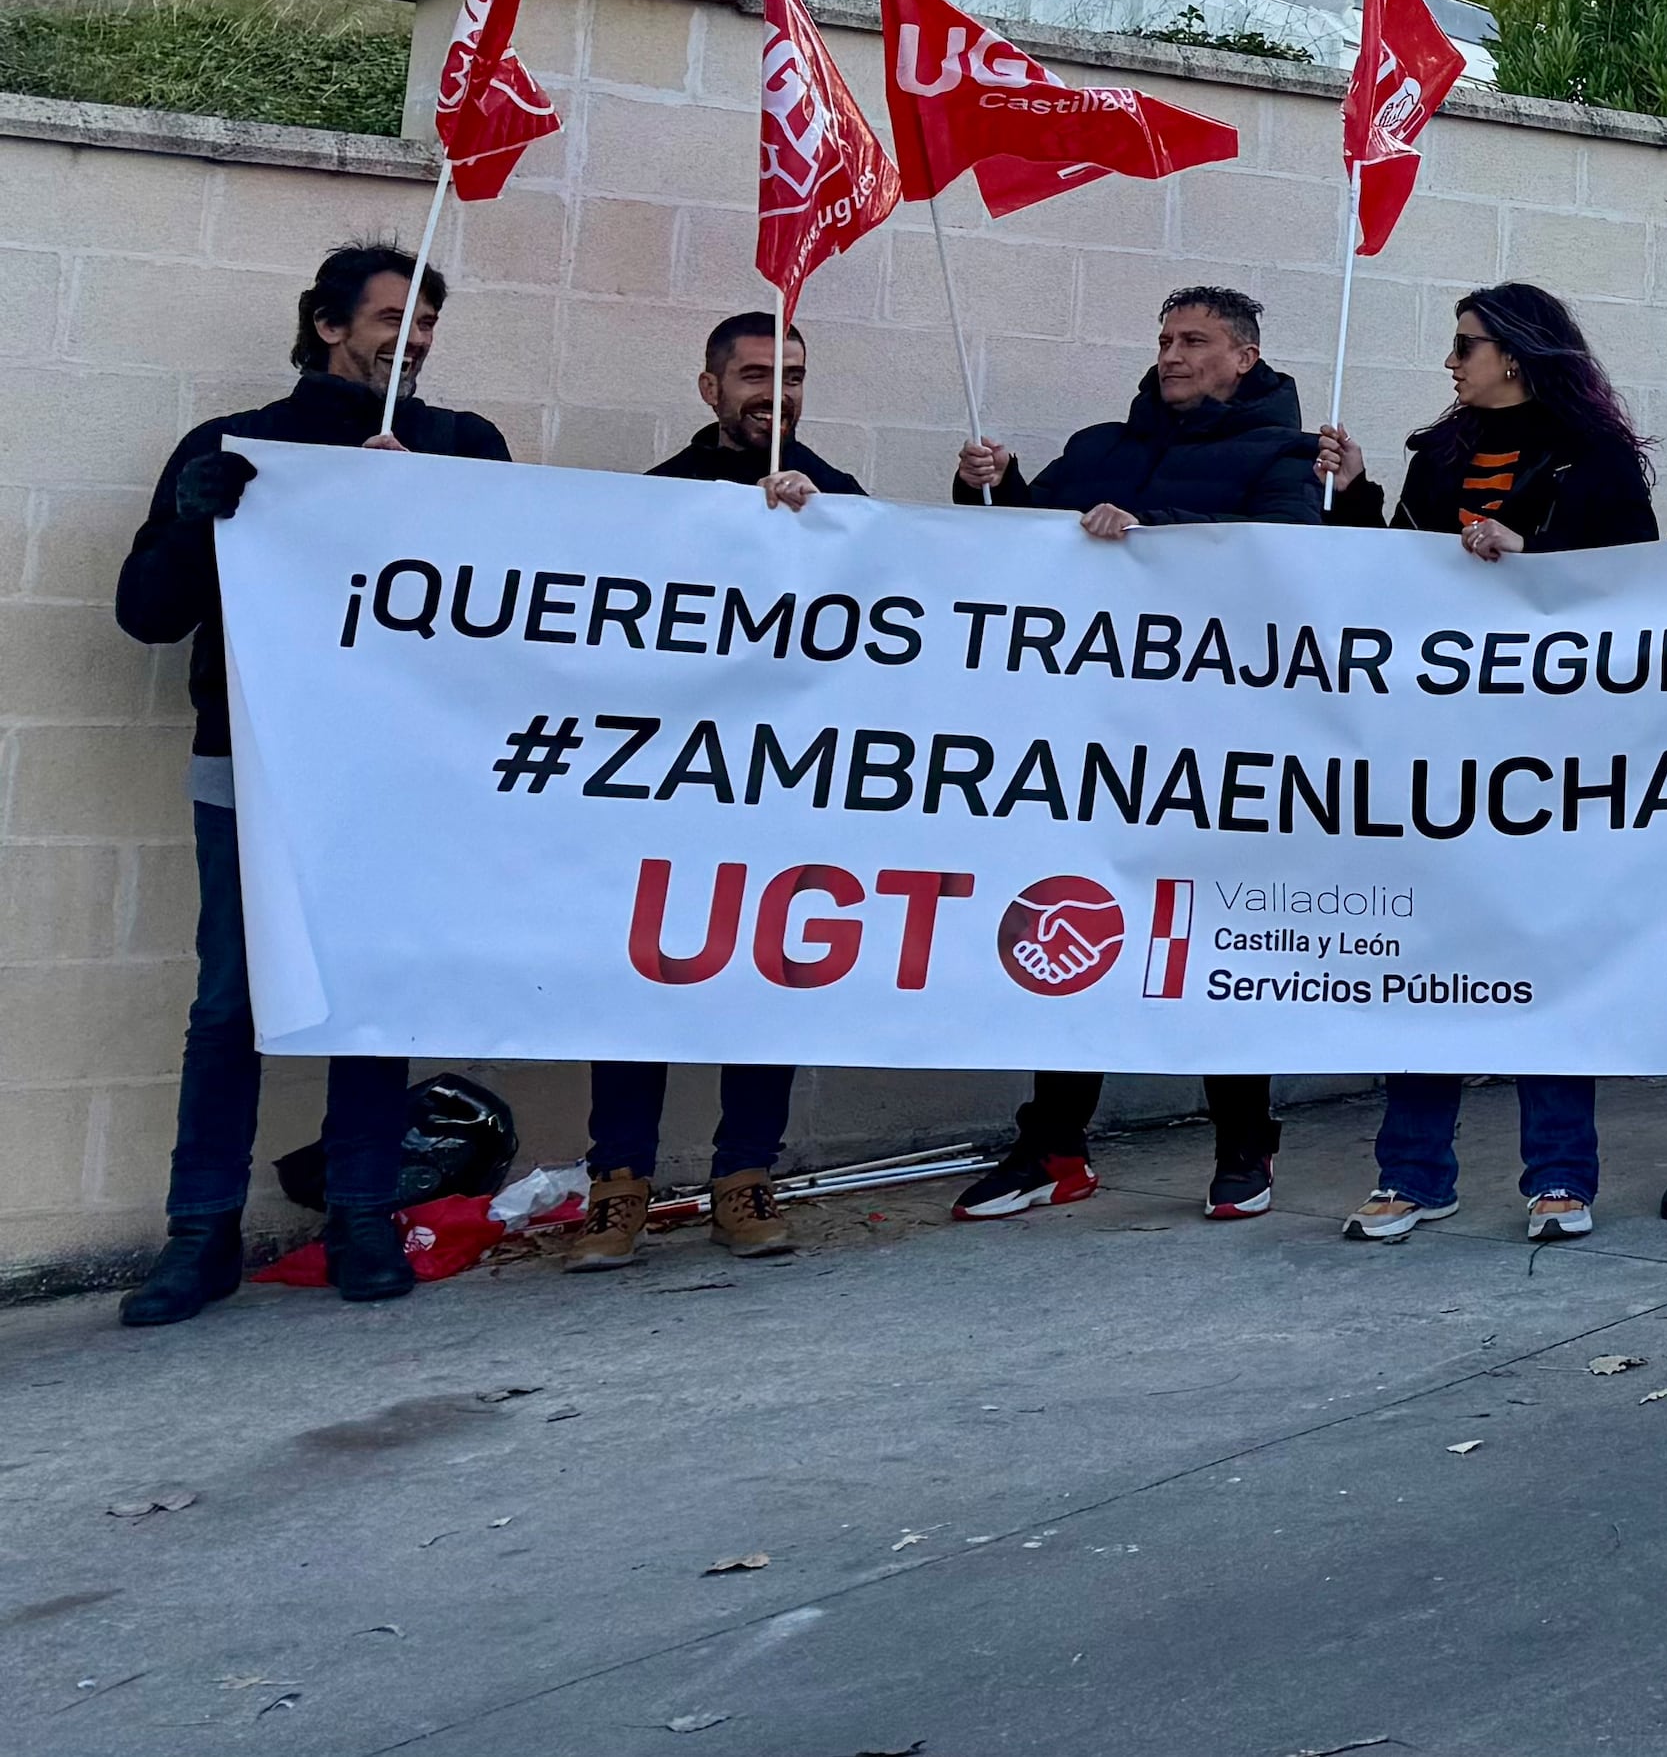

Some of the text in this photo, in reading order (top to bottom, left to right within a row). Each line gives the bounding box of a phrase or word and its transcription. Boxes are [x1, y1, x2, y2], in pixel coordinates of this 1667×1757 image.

[896, 23, 1065, 97] UG
[339, 558, 925, 667] ¡QUEREMOS
[953, 600, 1393, 695] TRABAJAR
[628, 858, 974, 991] UGT
[1214, 879, 1415, 919] Valladolid
[1213, 926, 1401, 961] Castilla y León
[1205, 966, 1534, 1005] Servicios Públicos
